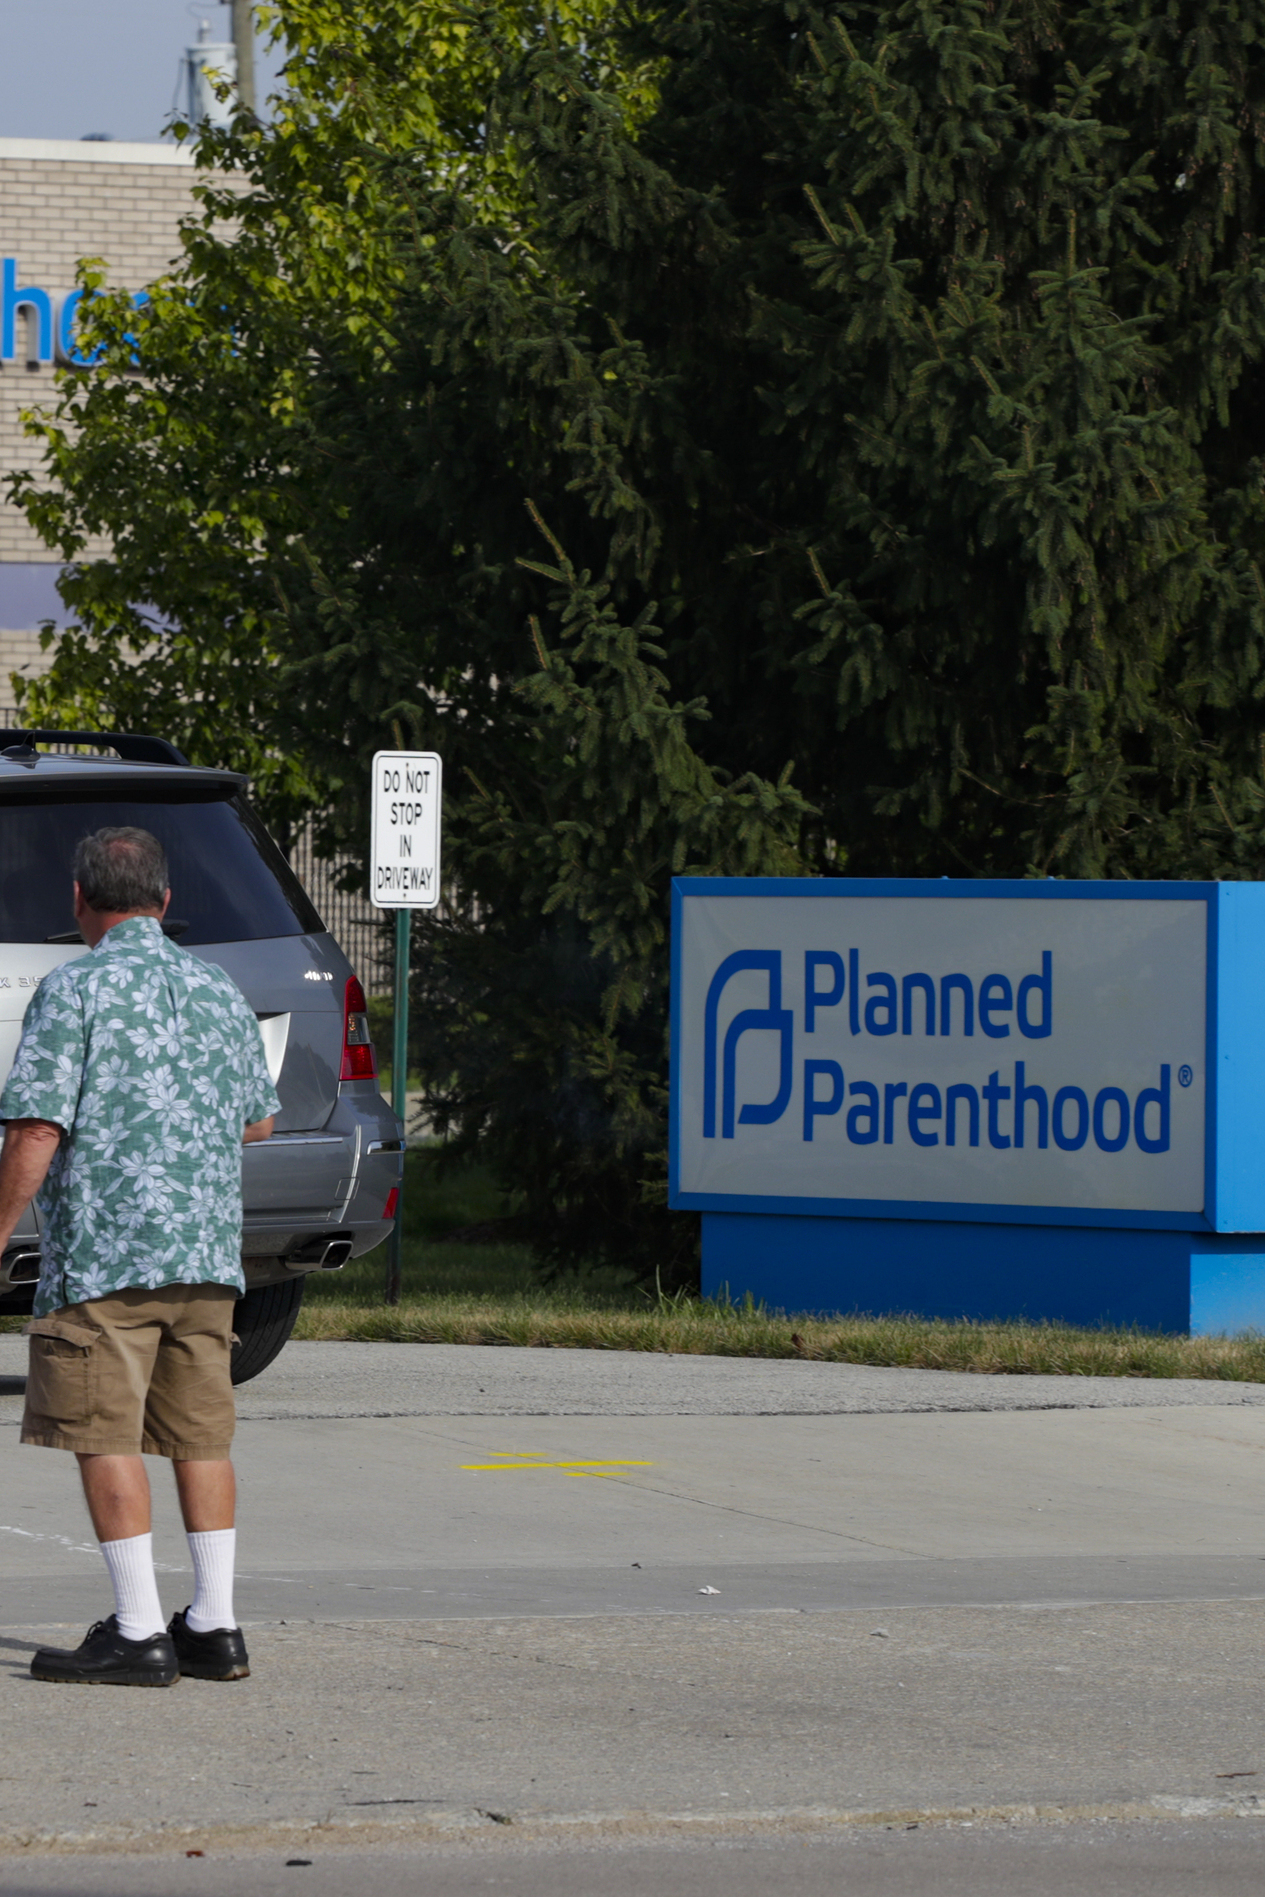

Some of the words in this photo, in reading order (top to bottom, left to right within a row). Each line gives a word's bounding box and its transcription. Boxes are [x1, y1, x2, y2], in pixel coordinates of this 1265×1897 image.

[383, 769, 401, 793] DO
[405, 770, 431, 794] NOT
[390, 802, 423, 826] STOP
[399, 834, 412, 858] IN
[377, 866, 434, 891] DRIVEWAY
[804, 948, 1053, 1040] Planned
